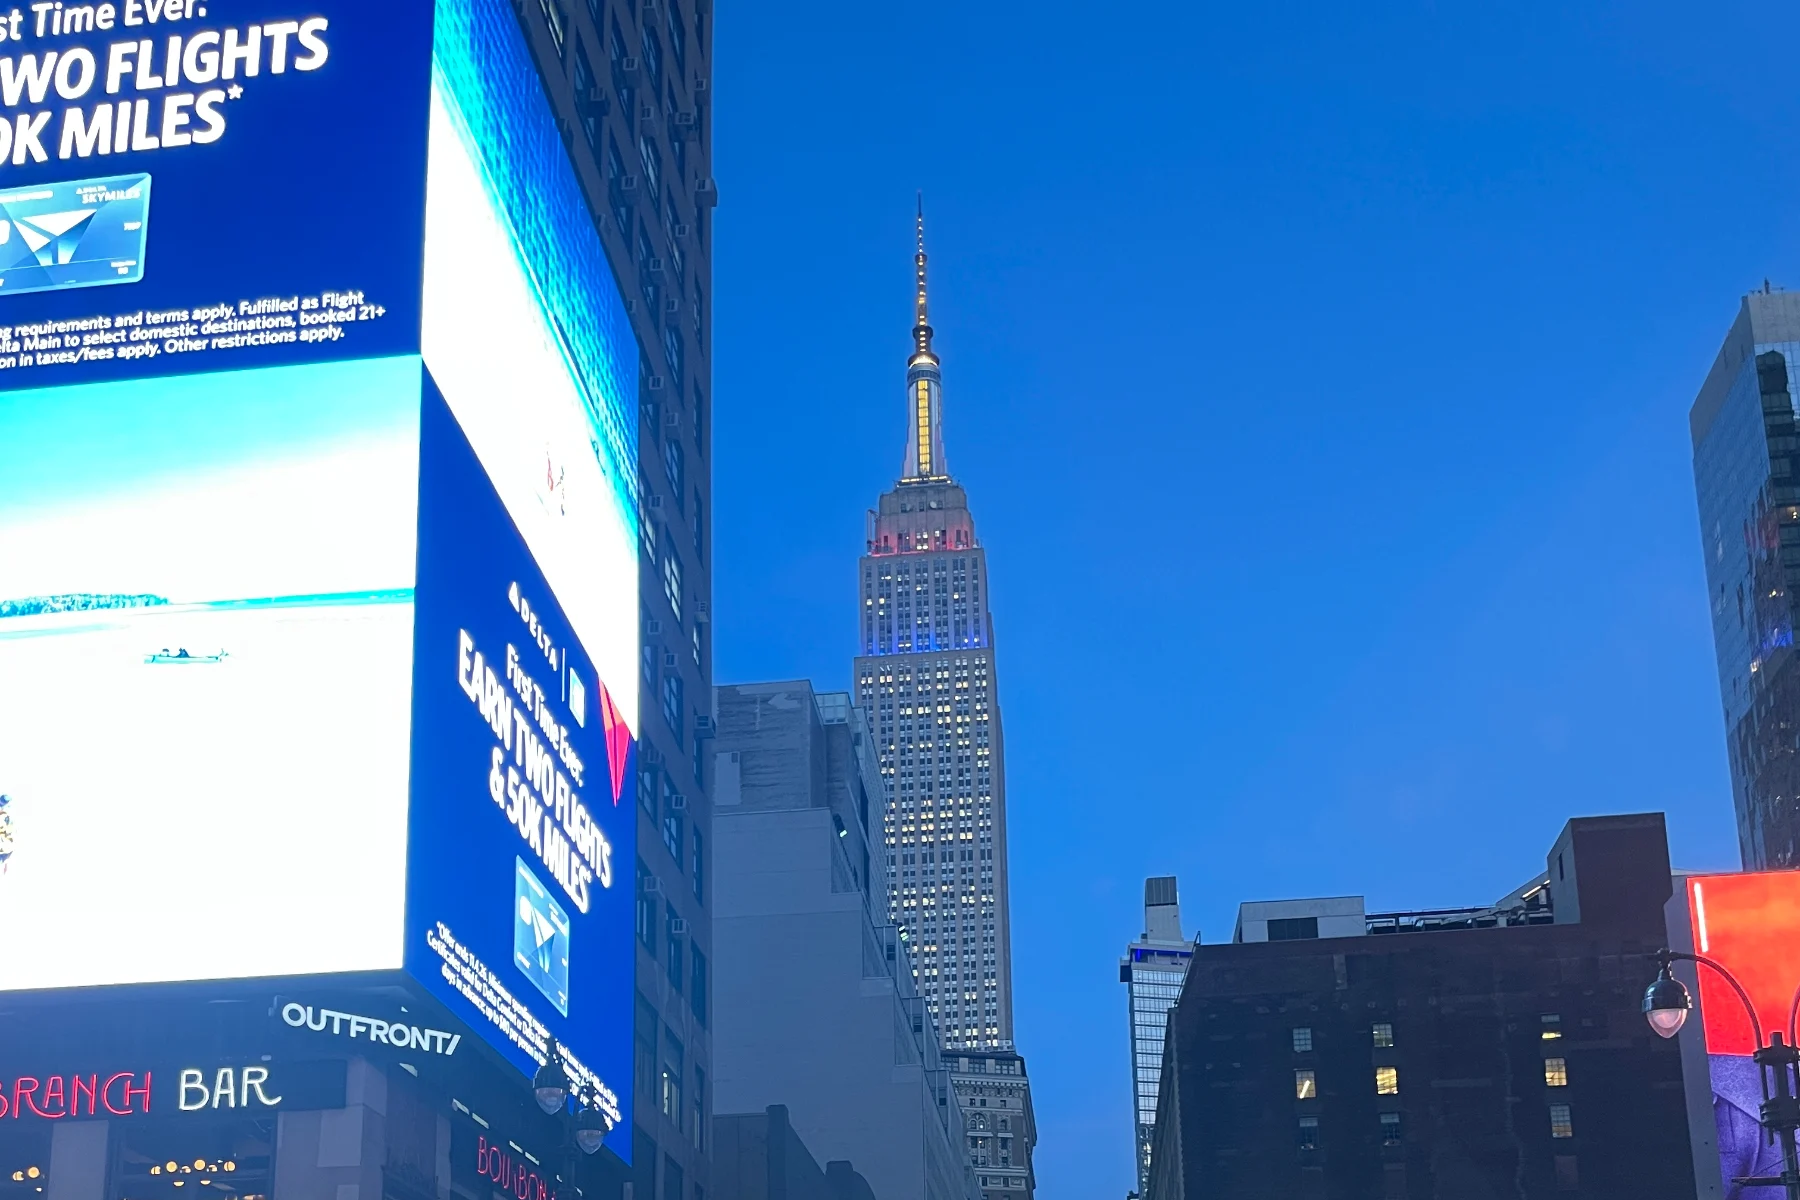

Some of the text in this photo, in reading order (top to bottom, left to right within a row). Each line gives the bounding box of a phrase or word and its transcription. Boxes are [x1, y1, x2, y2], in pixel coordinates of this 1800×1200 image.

[32, 2, 115, 38] Time
[124, 0, 206, 27] Ever.
[0, 17, 329, 106] WO FLIGHTS
[81, 188, 141, 204] SKYMILES
[15, 315, 111, 338] requirements
[114, 311, 143, 328] and
[145, 309, 189, 324] terms
[191, 303, 236, 322] apply.
[239, 296, 298, 315] Fulfilled
[301, 297, 319, 310] as
[322, 291, 364, 309] Flight
[23, 336, 61, 351] Main
[64, 334, 80, 347] to
[82, 329, 126, 346] select
[129, 323, 198, 342] domestic
[201, 315, 297, 335] destinations,
[299, 307, 356, 325] booked
[358, 305, 386, 321] 21+
[19, 354, 33, 367] in
[36, 346, 114, 365] taxes/fees
[117, 342, 161, 359] apply.
[164, 338, 207, 353] Other
[211, 330, 297, 349] restrictions
[299, 324, 345, 343] apply.
[520, 597, 557, 671] DELTA
[506, 643, 583, 787] First Time Ever.
[458, 628, 512, 751] EARN
[513, 707, 554, 807] TWO
[555, 770, 612, 888] FLIGHTS
[489, 746, 505, 809] &
[506, 766, 543, 857] 50K
[0, 1066, 282, 1119] RANCH BAR
